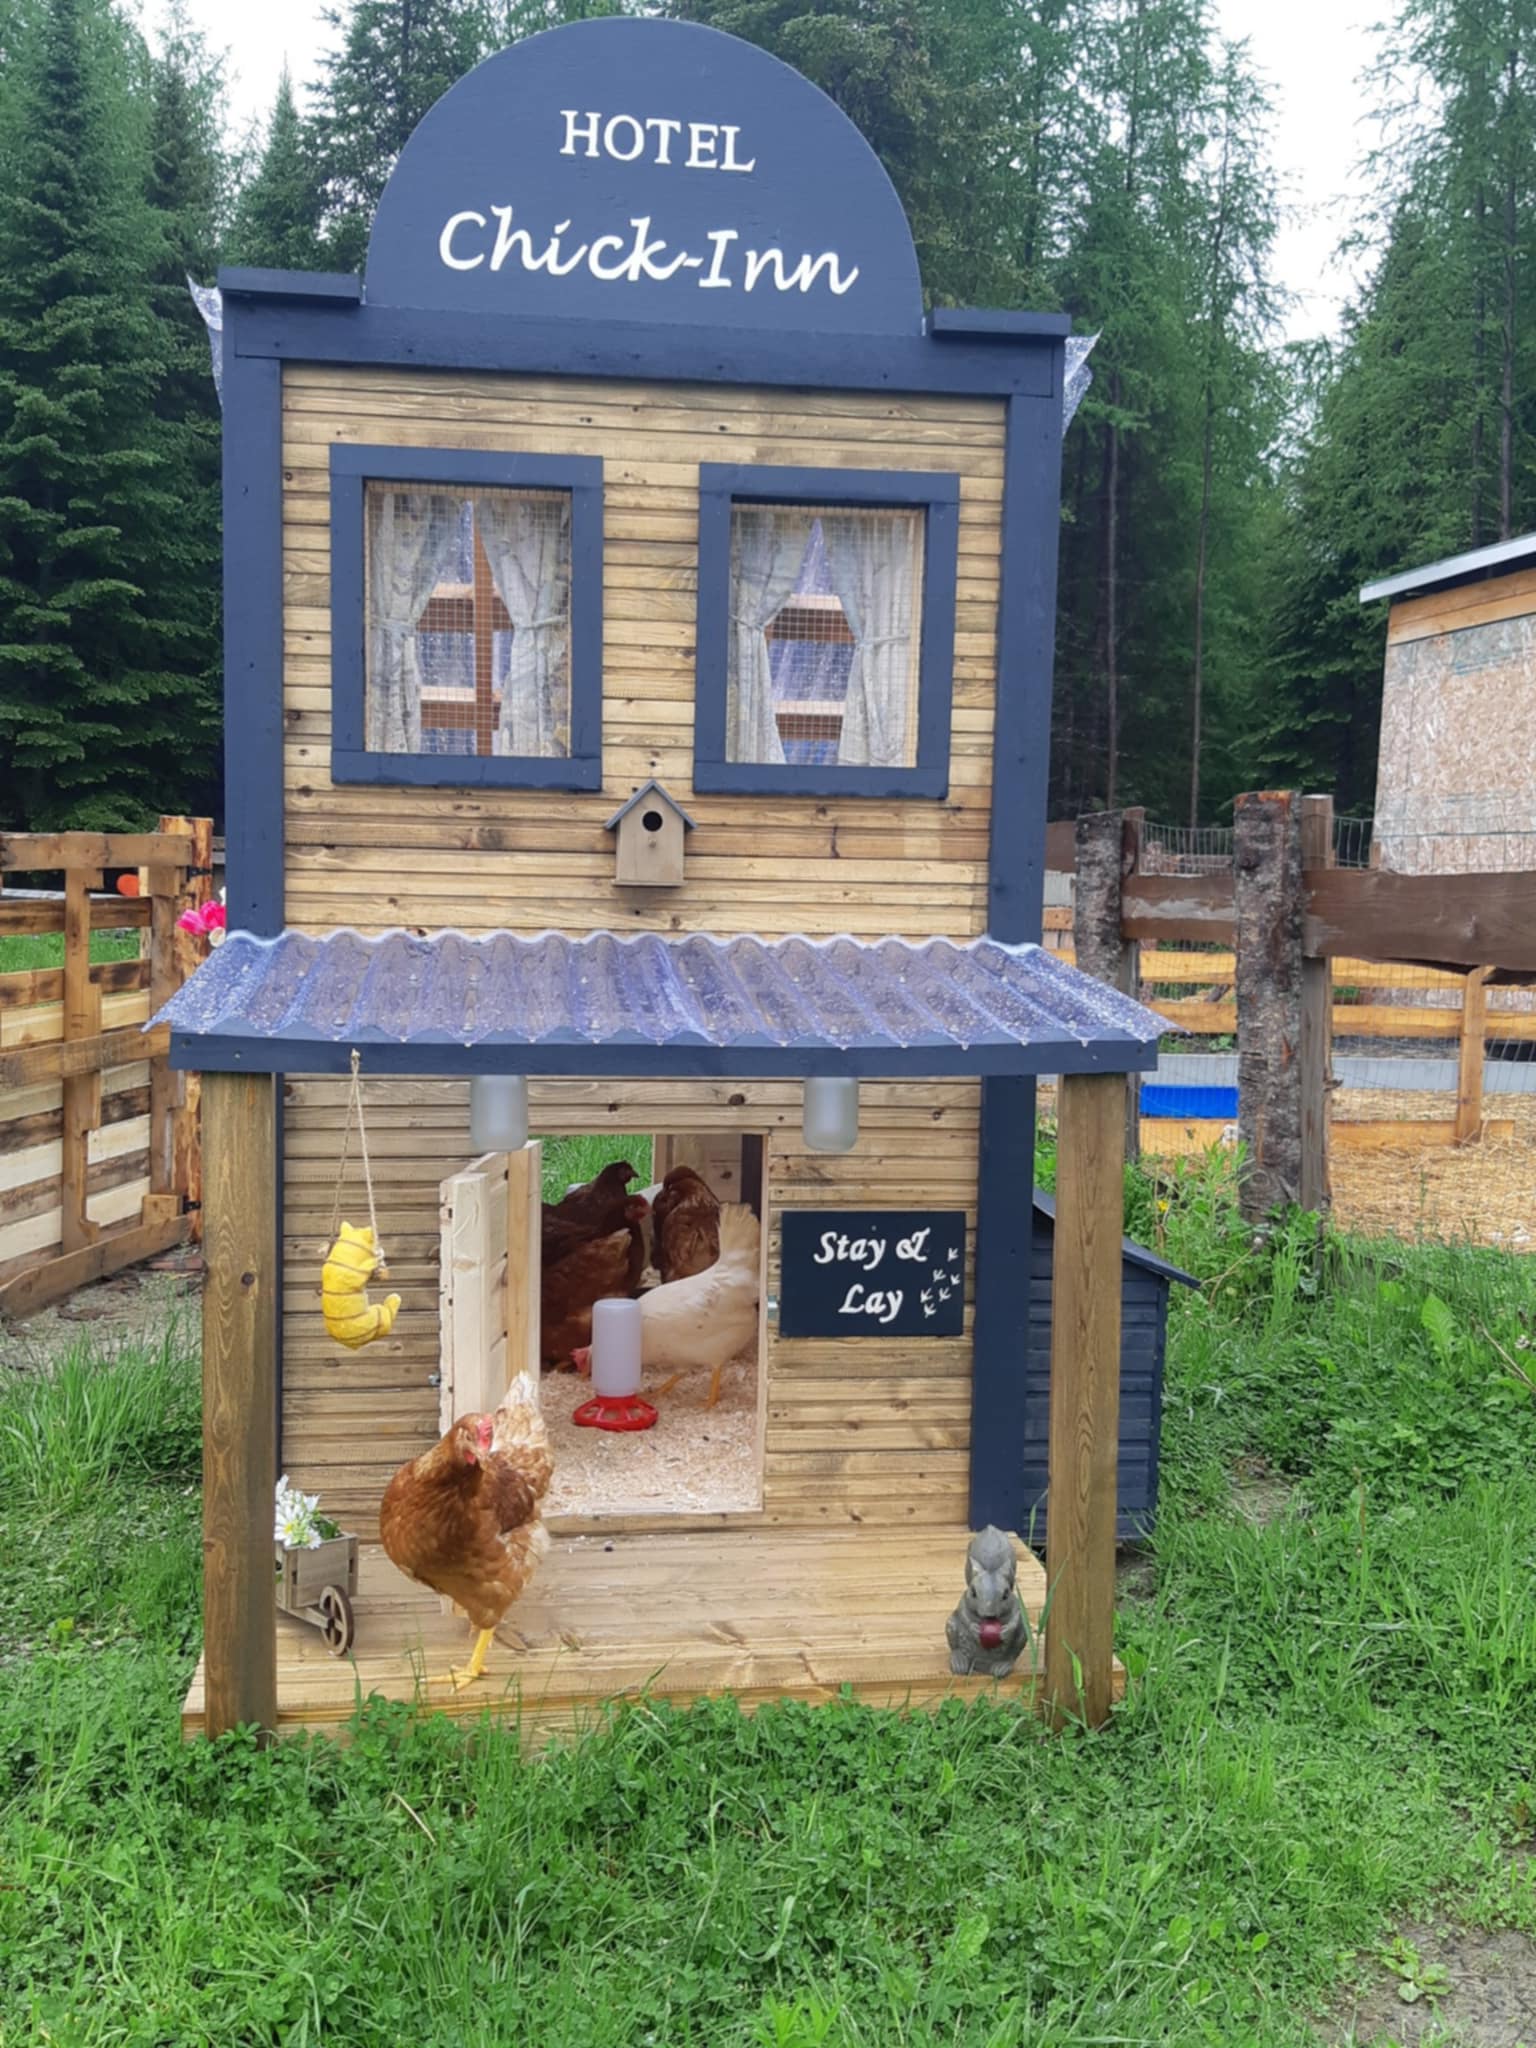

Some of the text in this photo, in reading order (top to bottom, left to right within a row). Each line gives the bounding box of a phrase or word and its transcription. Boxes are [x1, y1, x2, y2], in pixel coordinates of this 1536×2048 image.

[559, 109, 756, 173] HOTEL
[438, 204, 860, 296] Chick-Inn
[813, 1227, 931, 1271] Stay &
[838, 1283, 904, 1323] Lay
